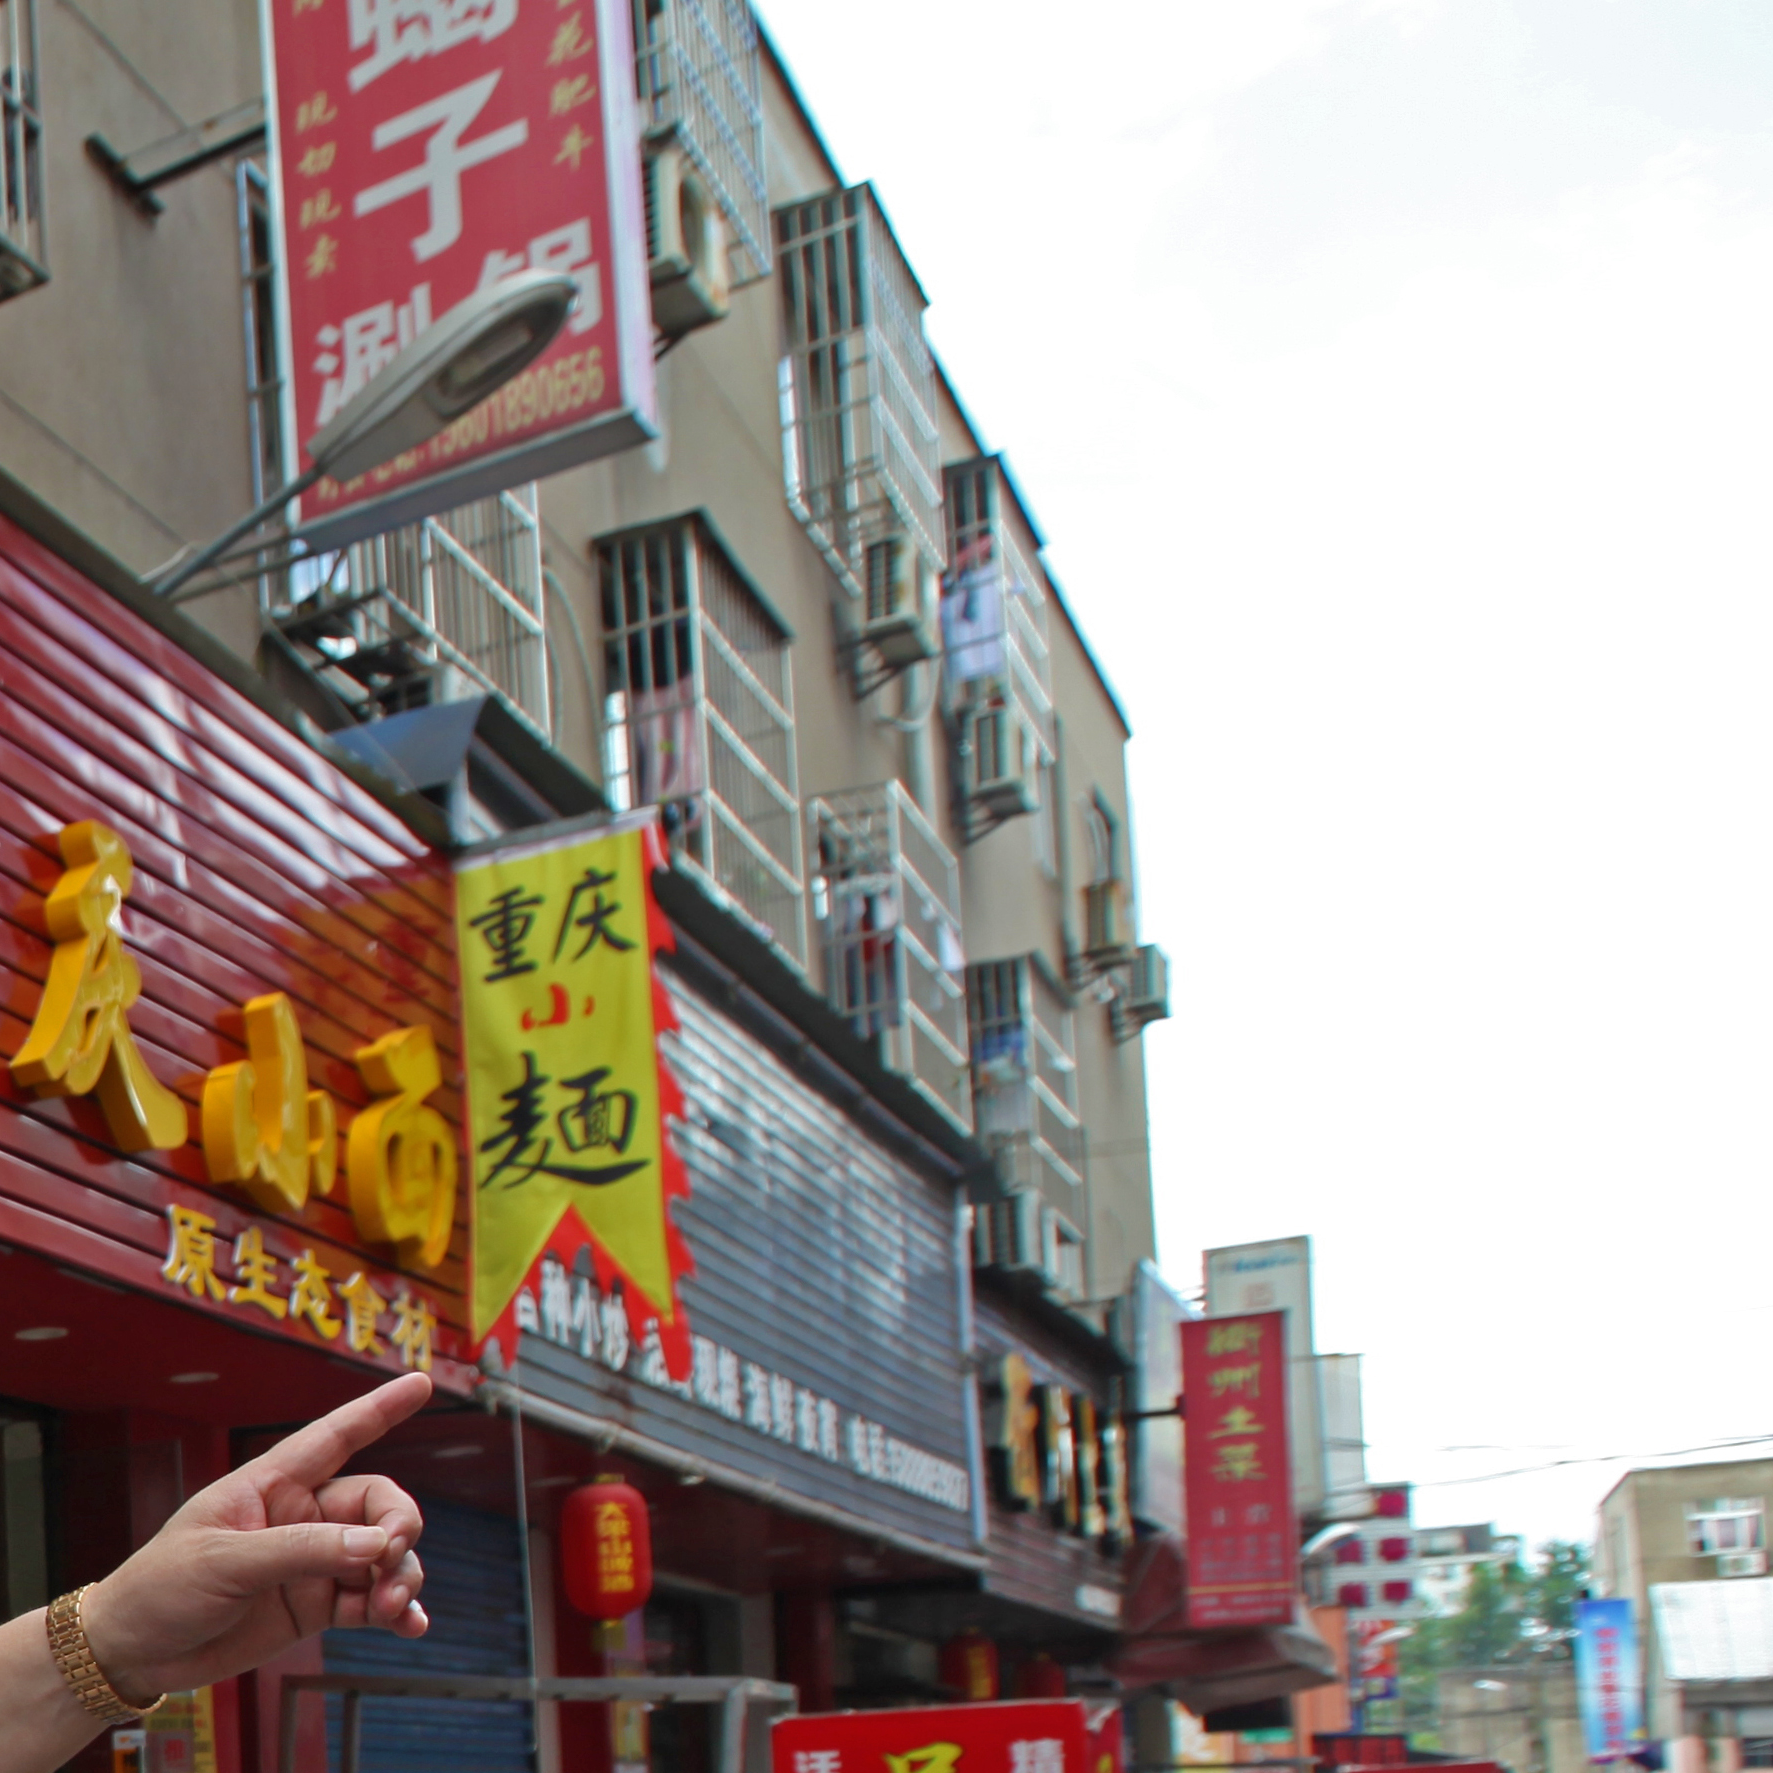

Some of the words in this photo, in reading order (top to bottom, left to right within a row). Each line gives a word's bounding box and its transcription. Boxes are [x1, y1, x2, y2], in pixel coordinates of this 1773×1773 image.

[466, 865, 638, 983] 重庆
[161, 1203, 437, 1373] 原生态食材
